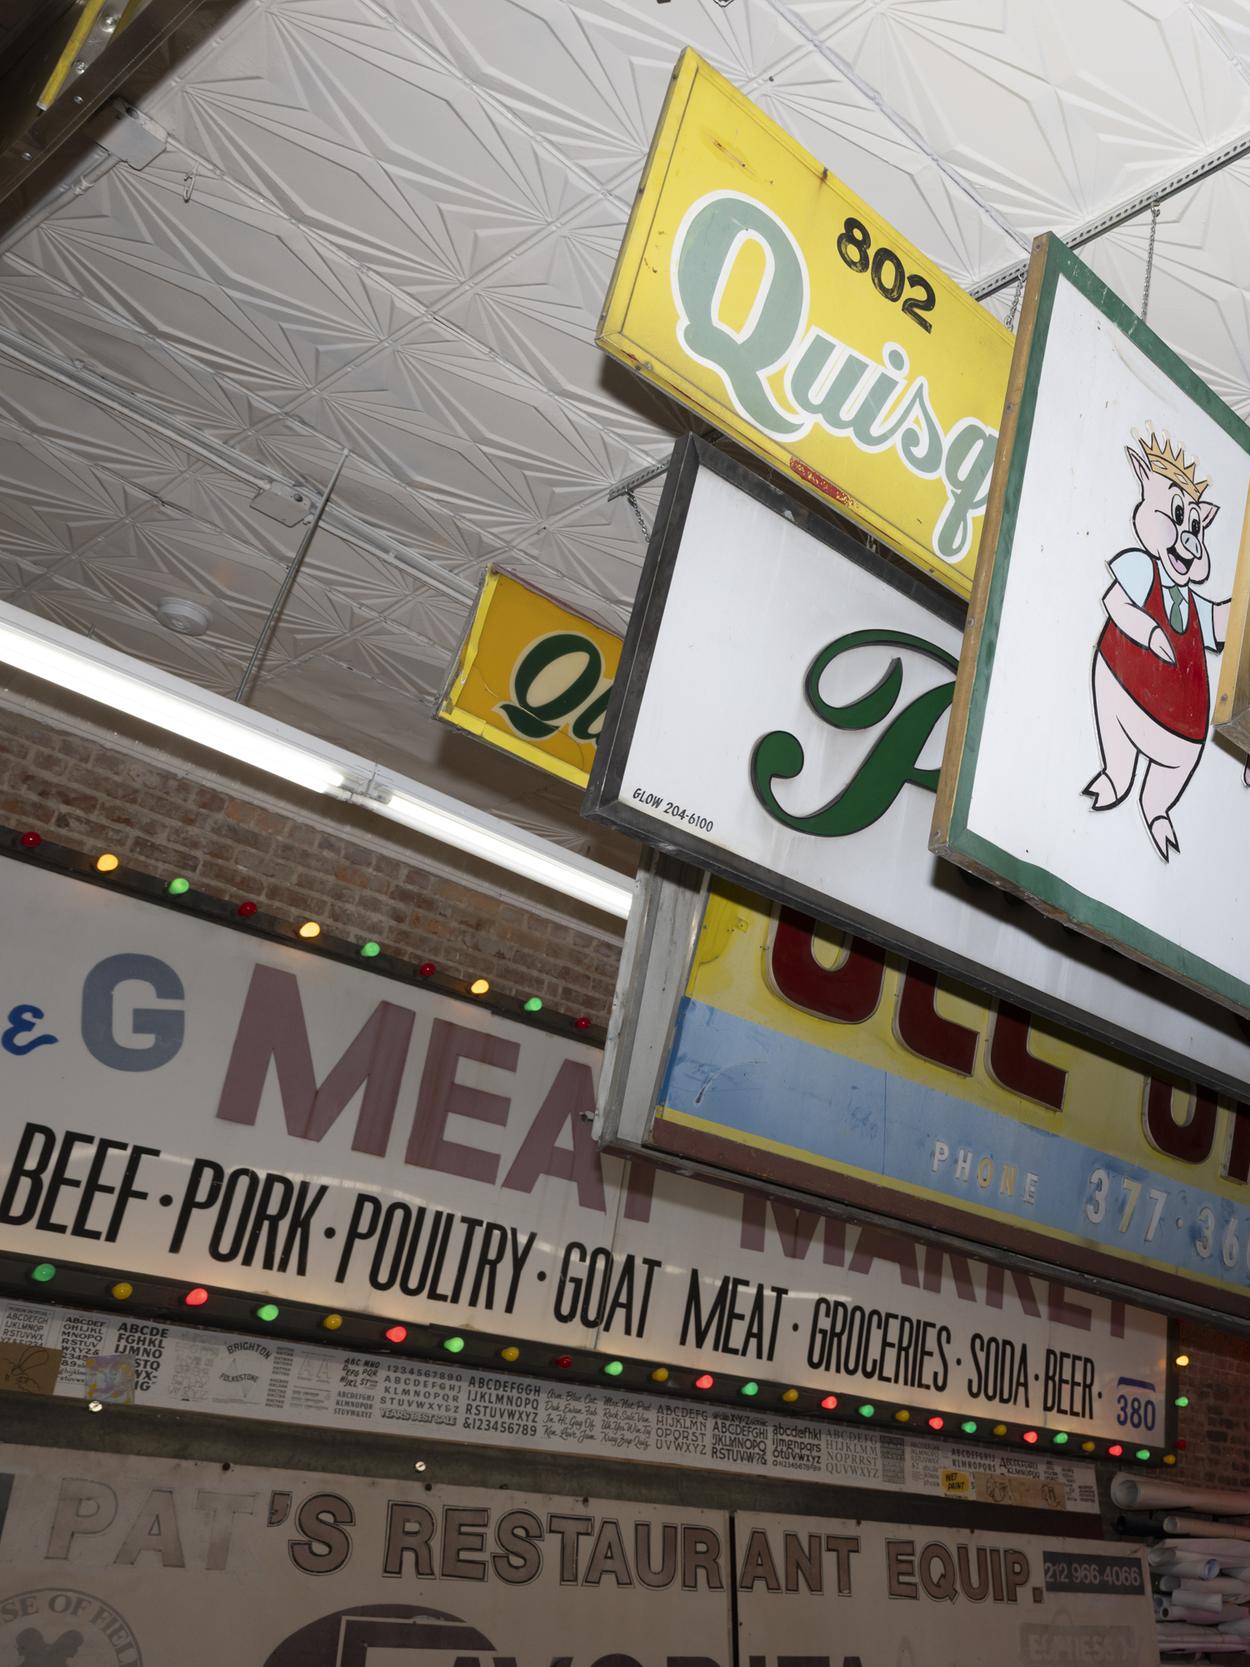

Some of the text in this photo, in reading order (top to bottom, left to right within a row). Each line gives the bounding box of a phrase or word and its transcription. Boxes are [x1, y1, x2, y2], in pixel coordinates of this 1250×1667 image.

[836, 216, 937, 334] 802
[633, 788, 714, 833] GLOW 204-6100
[81, 953, 185, 1073] G
[931, 1140, 1040, 1205] PHONE
[1, 1121, 161, 1244] BEEF
[168, 1157, 336, 1278] PORK
[334, 1191, 538, 1315] POULTRY
[553, 1240, 663, 1339] GOAT
[679, 1267, 788, 1363] MEAT
[806, 1297, 952, 1394] GROCERIES
[966, 1333, 1031, 1410] SODA
[1042, 1348, 1097, 1421] BEER
[117, 1333, 166, 1349] FGHKL
[118, 1322, 169, 1339] ABCDE
[114, 1344, 163, 1360] IJMNO
[227, 1342, 272, 1360] BRIGHTON
[466, 1390, 539, 1411] IJKLMNOPQ
[465, 1403, 538, 1424] RSTUVWXYZ
[656, 1404, 708, 1421] ABCDEFG
[656, 1415, 707, 1431] HIJKLMN
[1117, 1394, 1157, 1432] 380
[655, 1427, 706, 1443] OPQRST
[825, 1428, 878, 1445] ABCDEFG
[655, 1439, 707, 1455] UVWXYZ
[44, 1477, 1044, 1606] PAT'S RESTAURANT EQUIP.
[1045, 1562, 1069, 1583] 212
[48, 1593, 92, 1617] OF
